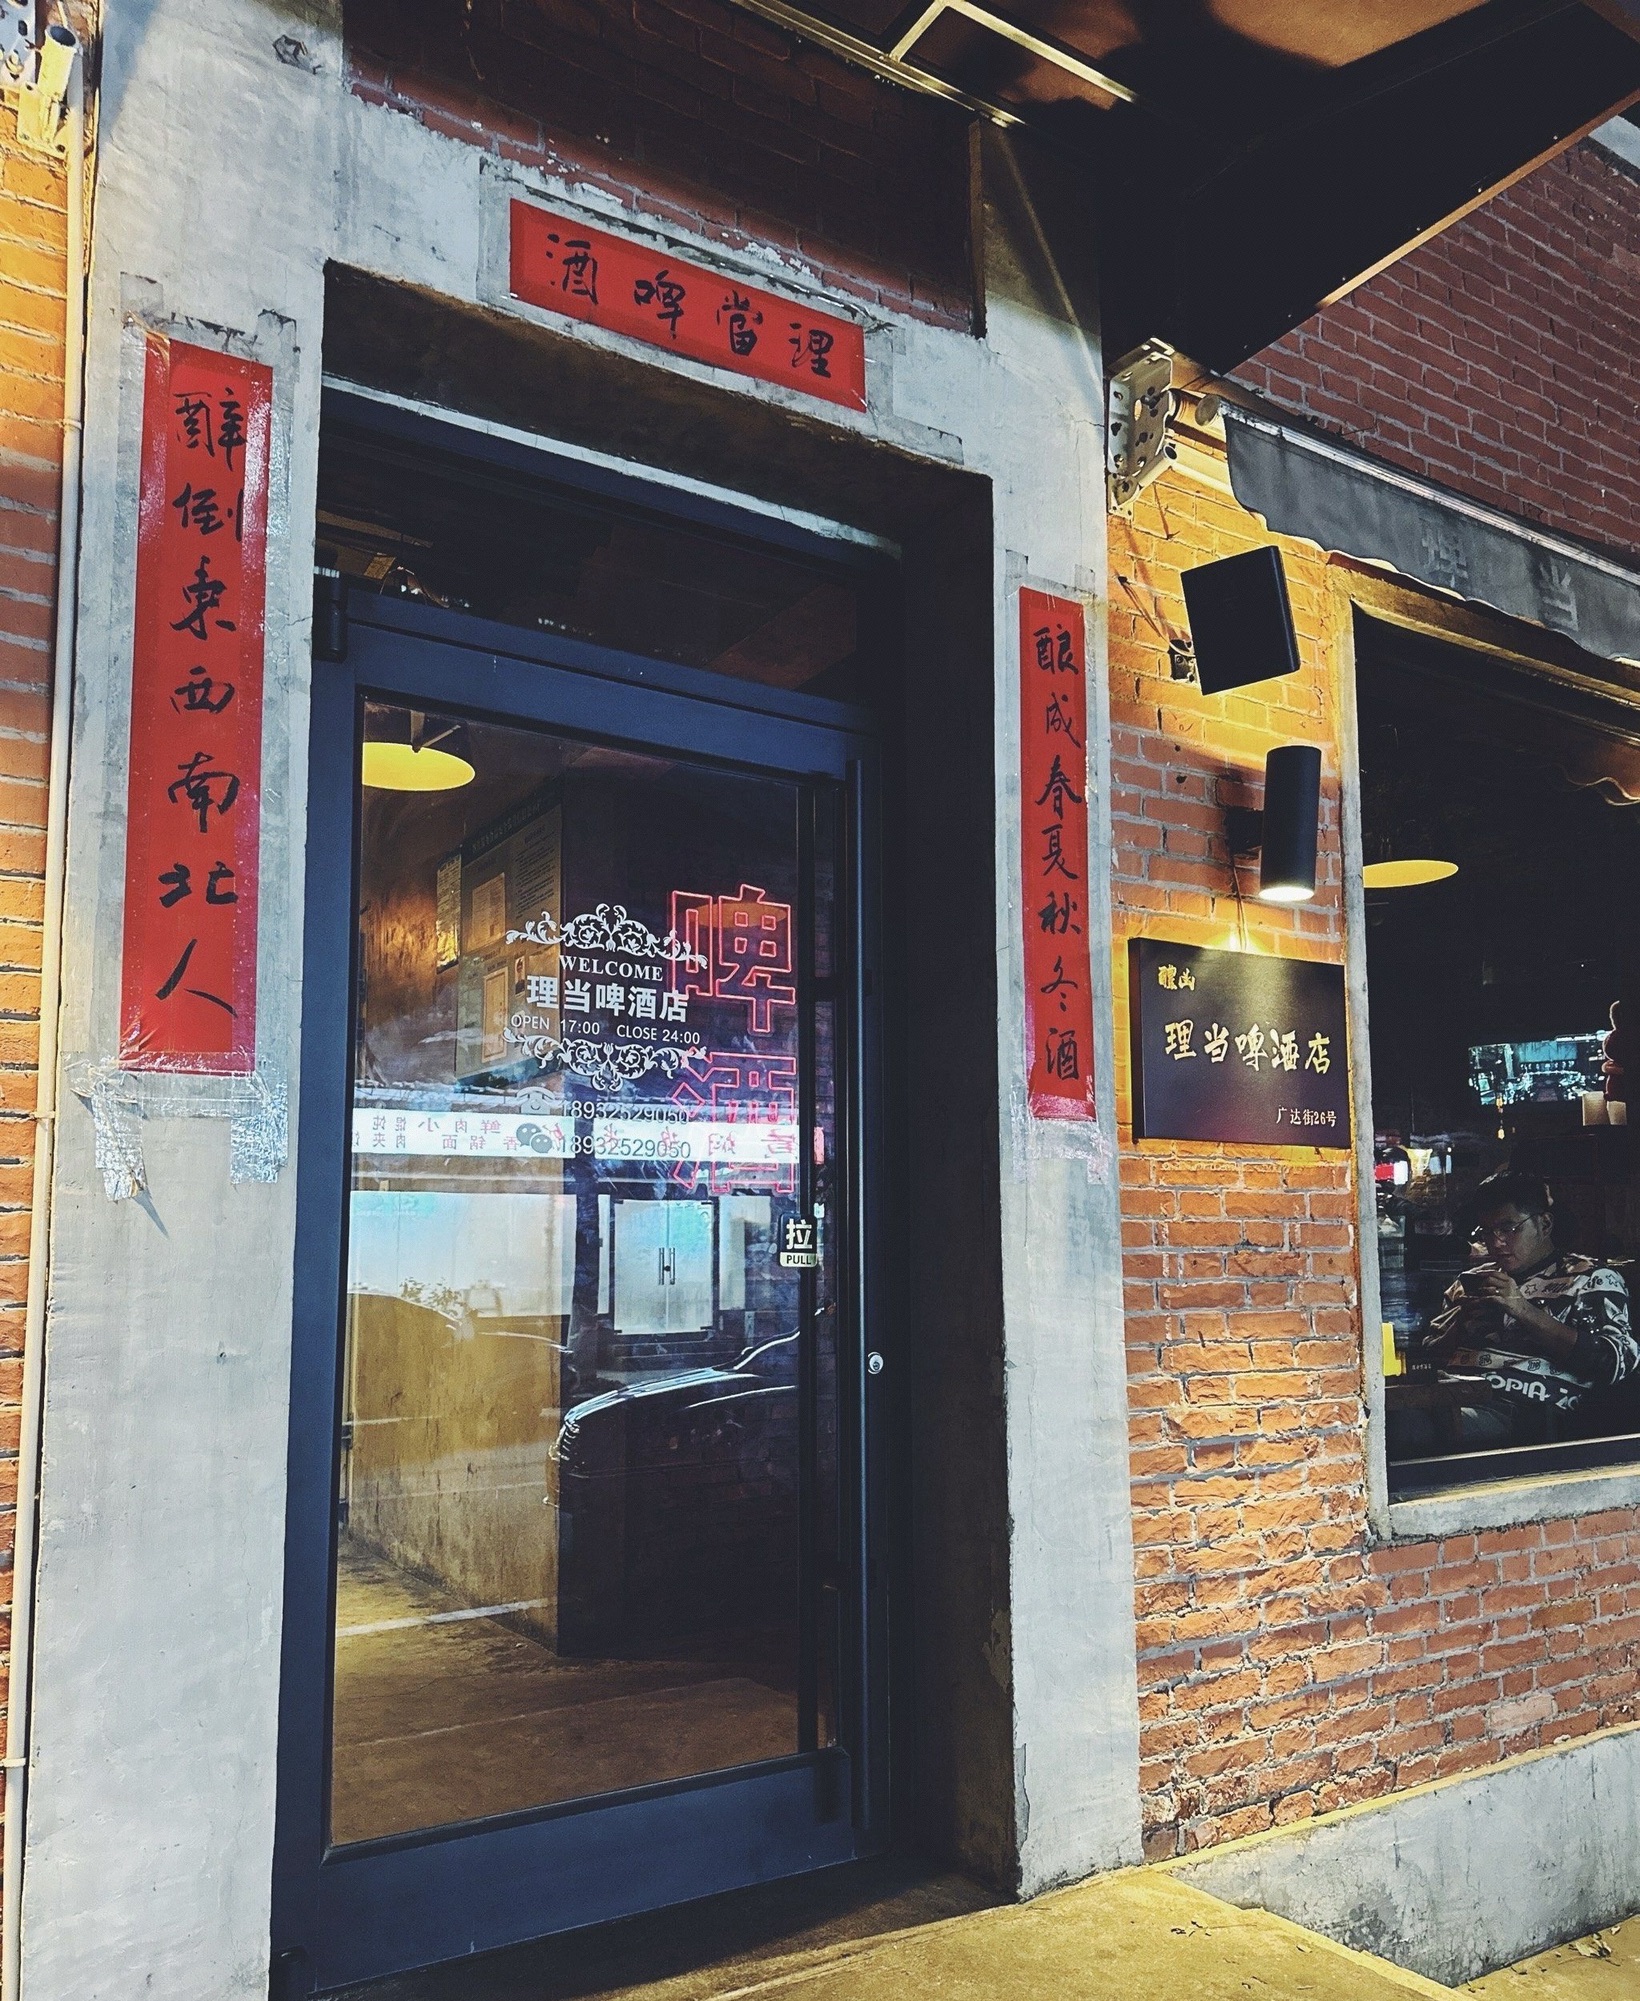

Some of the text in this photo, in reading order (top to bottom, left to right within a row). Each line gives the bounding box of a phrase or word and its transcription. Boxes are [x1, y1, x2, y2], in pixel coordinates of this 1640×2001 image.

[559, 954, 664, 982] WELCOME
[526, 974, 690, 1023] 理当啤酒店
[510, 1014, 700, 1045] OPEN 17:00 CLOSE 24:00
[1164, 1018, 1332, 1075] 理当啤酒店
[1275, 1105, 1338, 1128] 广达街26号
[785, 1218, 813, 1250] 拉
[786, 1255, 812, 1265] PULL
